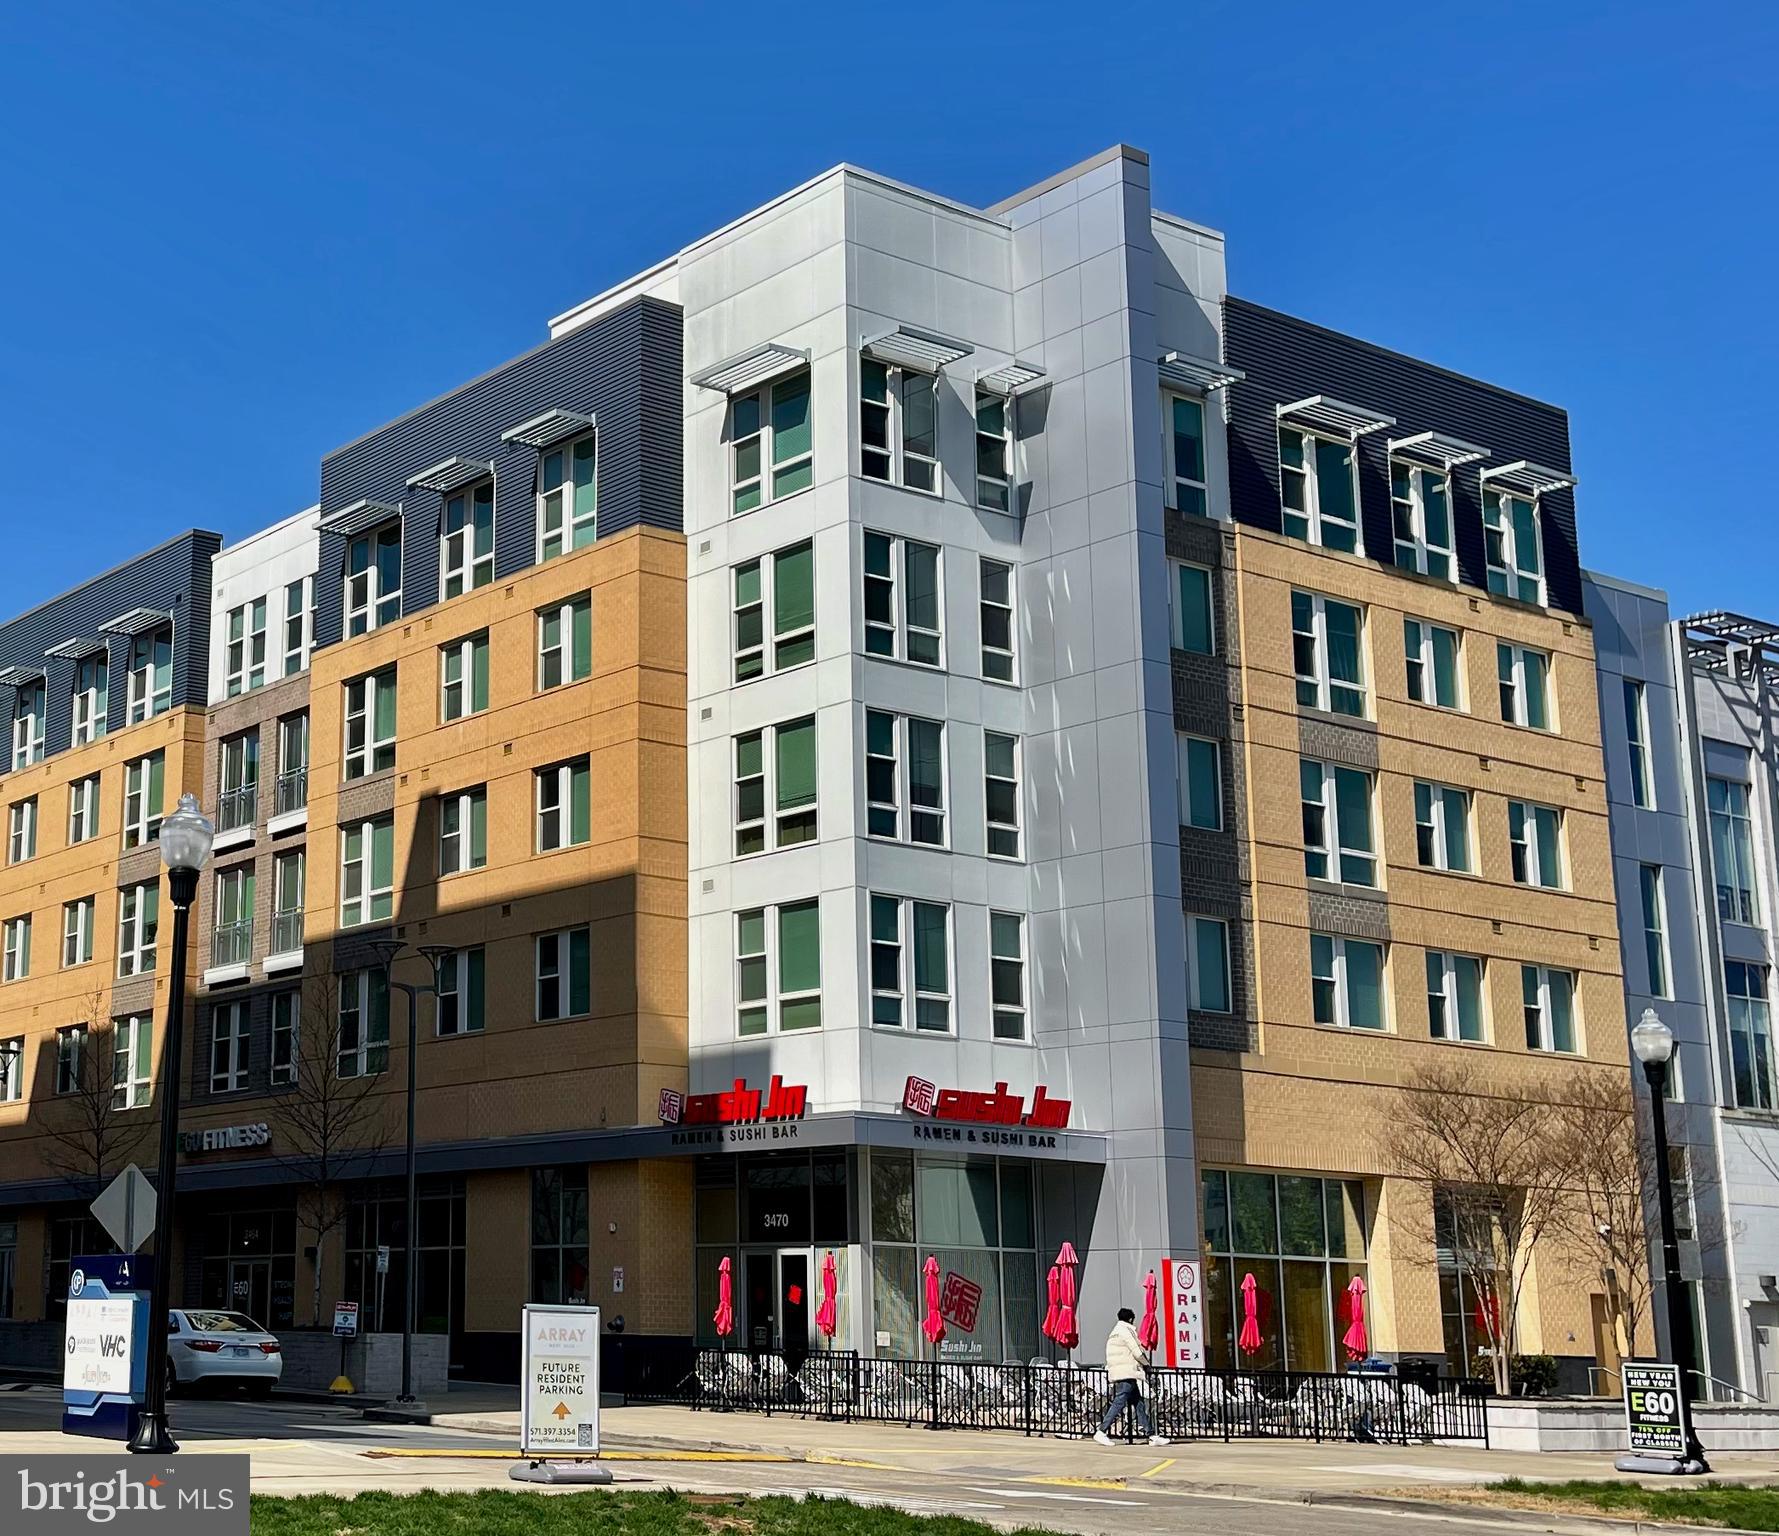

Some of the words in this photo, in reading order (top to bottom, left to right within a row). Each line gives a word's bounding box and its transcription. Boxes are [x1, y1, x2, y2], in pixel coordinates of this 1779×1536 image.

[203, 1123, 268, 1150] FITNESS
[671, 1132, 712, 1146] RAMEN
[717, 1131, 724, 1142] &
[729, 1127, 766, 1142] SUSHI
[772, 1125, 798, 1139] BAR
[913, 1125, 961, 1141] RAMEN
[967, 1130, 976, 1142] &
[982, 1131, 1023, 1146] SUSHI
[1028, 1135, 1056, 1148] BAR
[764, 1214, 789, 1227] 3470
[538, 1327, 586, 1342] ARRAY
[100, 1334, 126, 1357] VHC
[940, 1340, 968, 1352] Sushi
[968, 1340, 982, 1353] Jin
[542, 1362, 580, 1373] FUTURE
[537, 1374, 585, 1385] RESIDENT
[1627, 1371, 1647, 1379] NEW
[1649, 1372, 1674, 1380] YEAR
[1630, 1379, 1651, 1387] NEW
[539, 1385, 584, 1395] PARKING
[1631, 1391, 1675, 1415] E60
[1639, 1414, 1670, 1422] FITNESS
[530, 1427, 576, 1436] 571.397.3354
[1631, 1432, 1651, 1440] FIRST
[1653, 1433, 1681, 1442] MONTH
